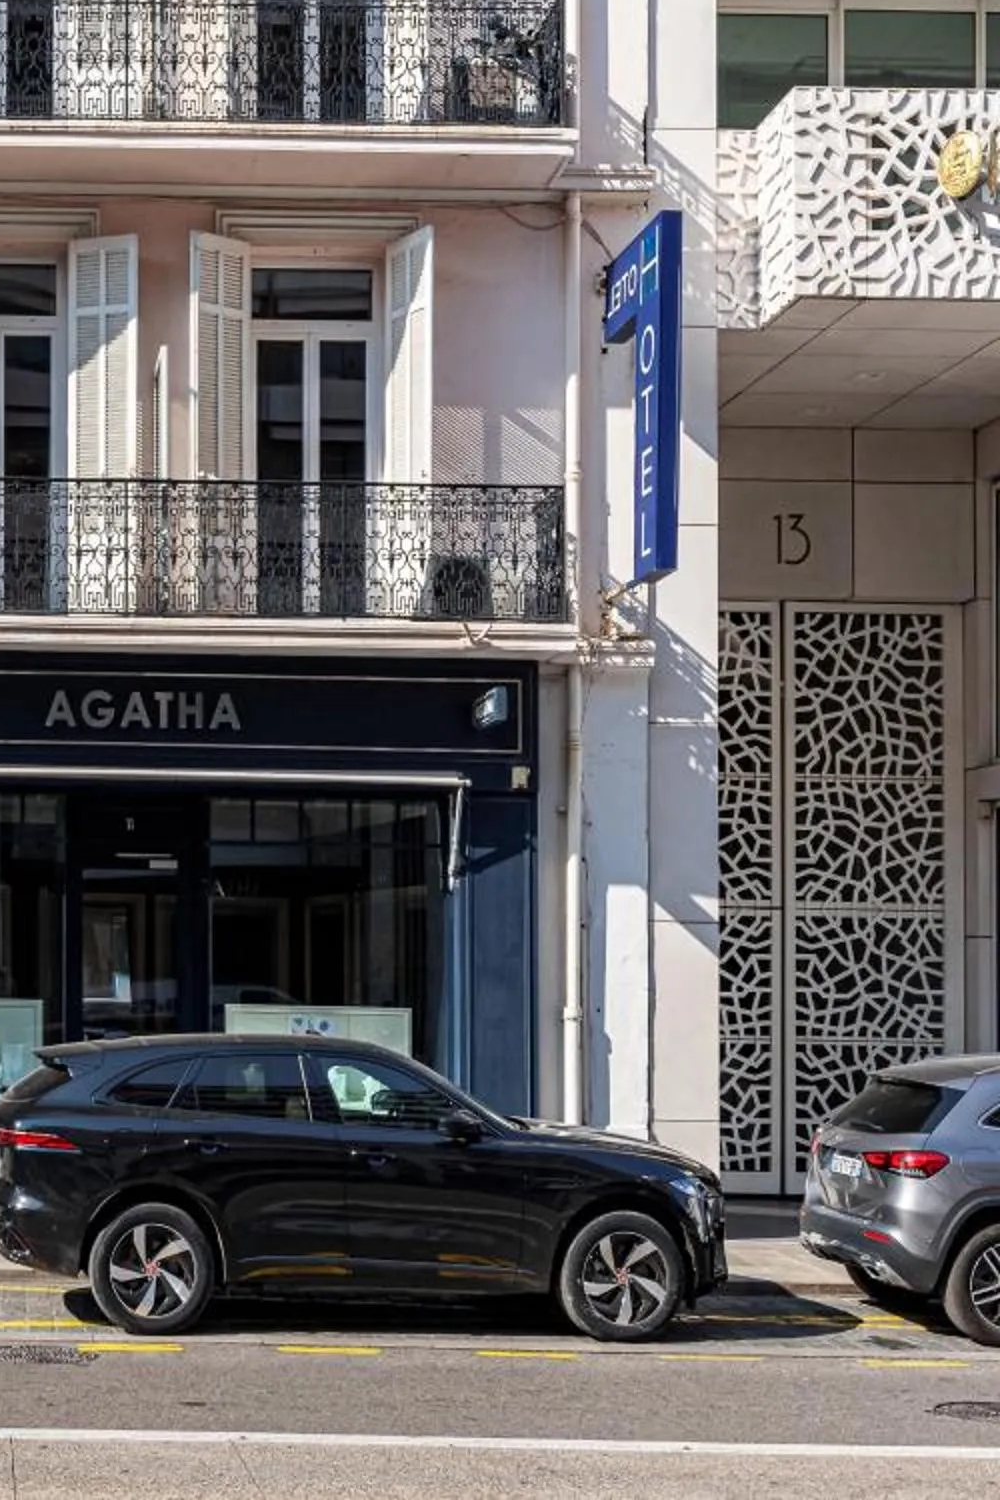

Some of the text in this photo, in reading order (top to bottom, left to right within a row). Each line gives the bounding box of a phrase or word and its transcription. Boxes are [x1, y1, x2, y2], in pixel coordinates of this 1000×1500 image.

[639, 225, 660, 559] HOTEL
[773, 513, 811, 565] 13
[44, 688, 241, 731] AGATHA
